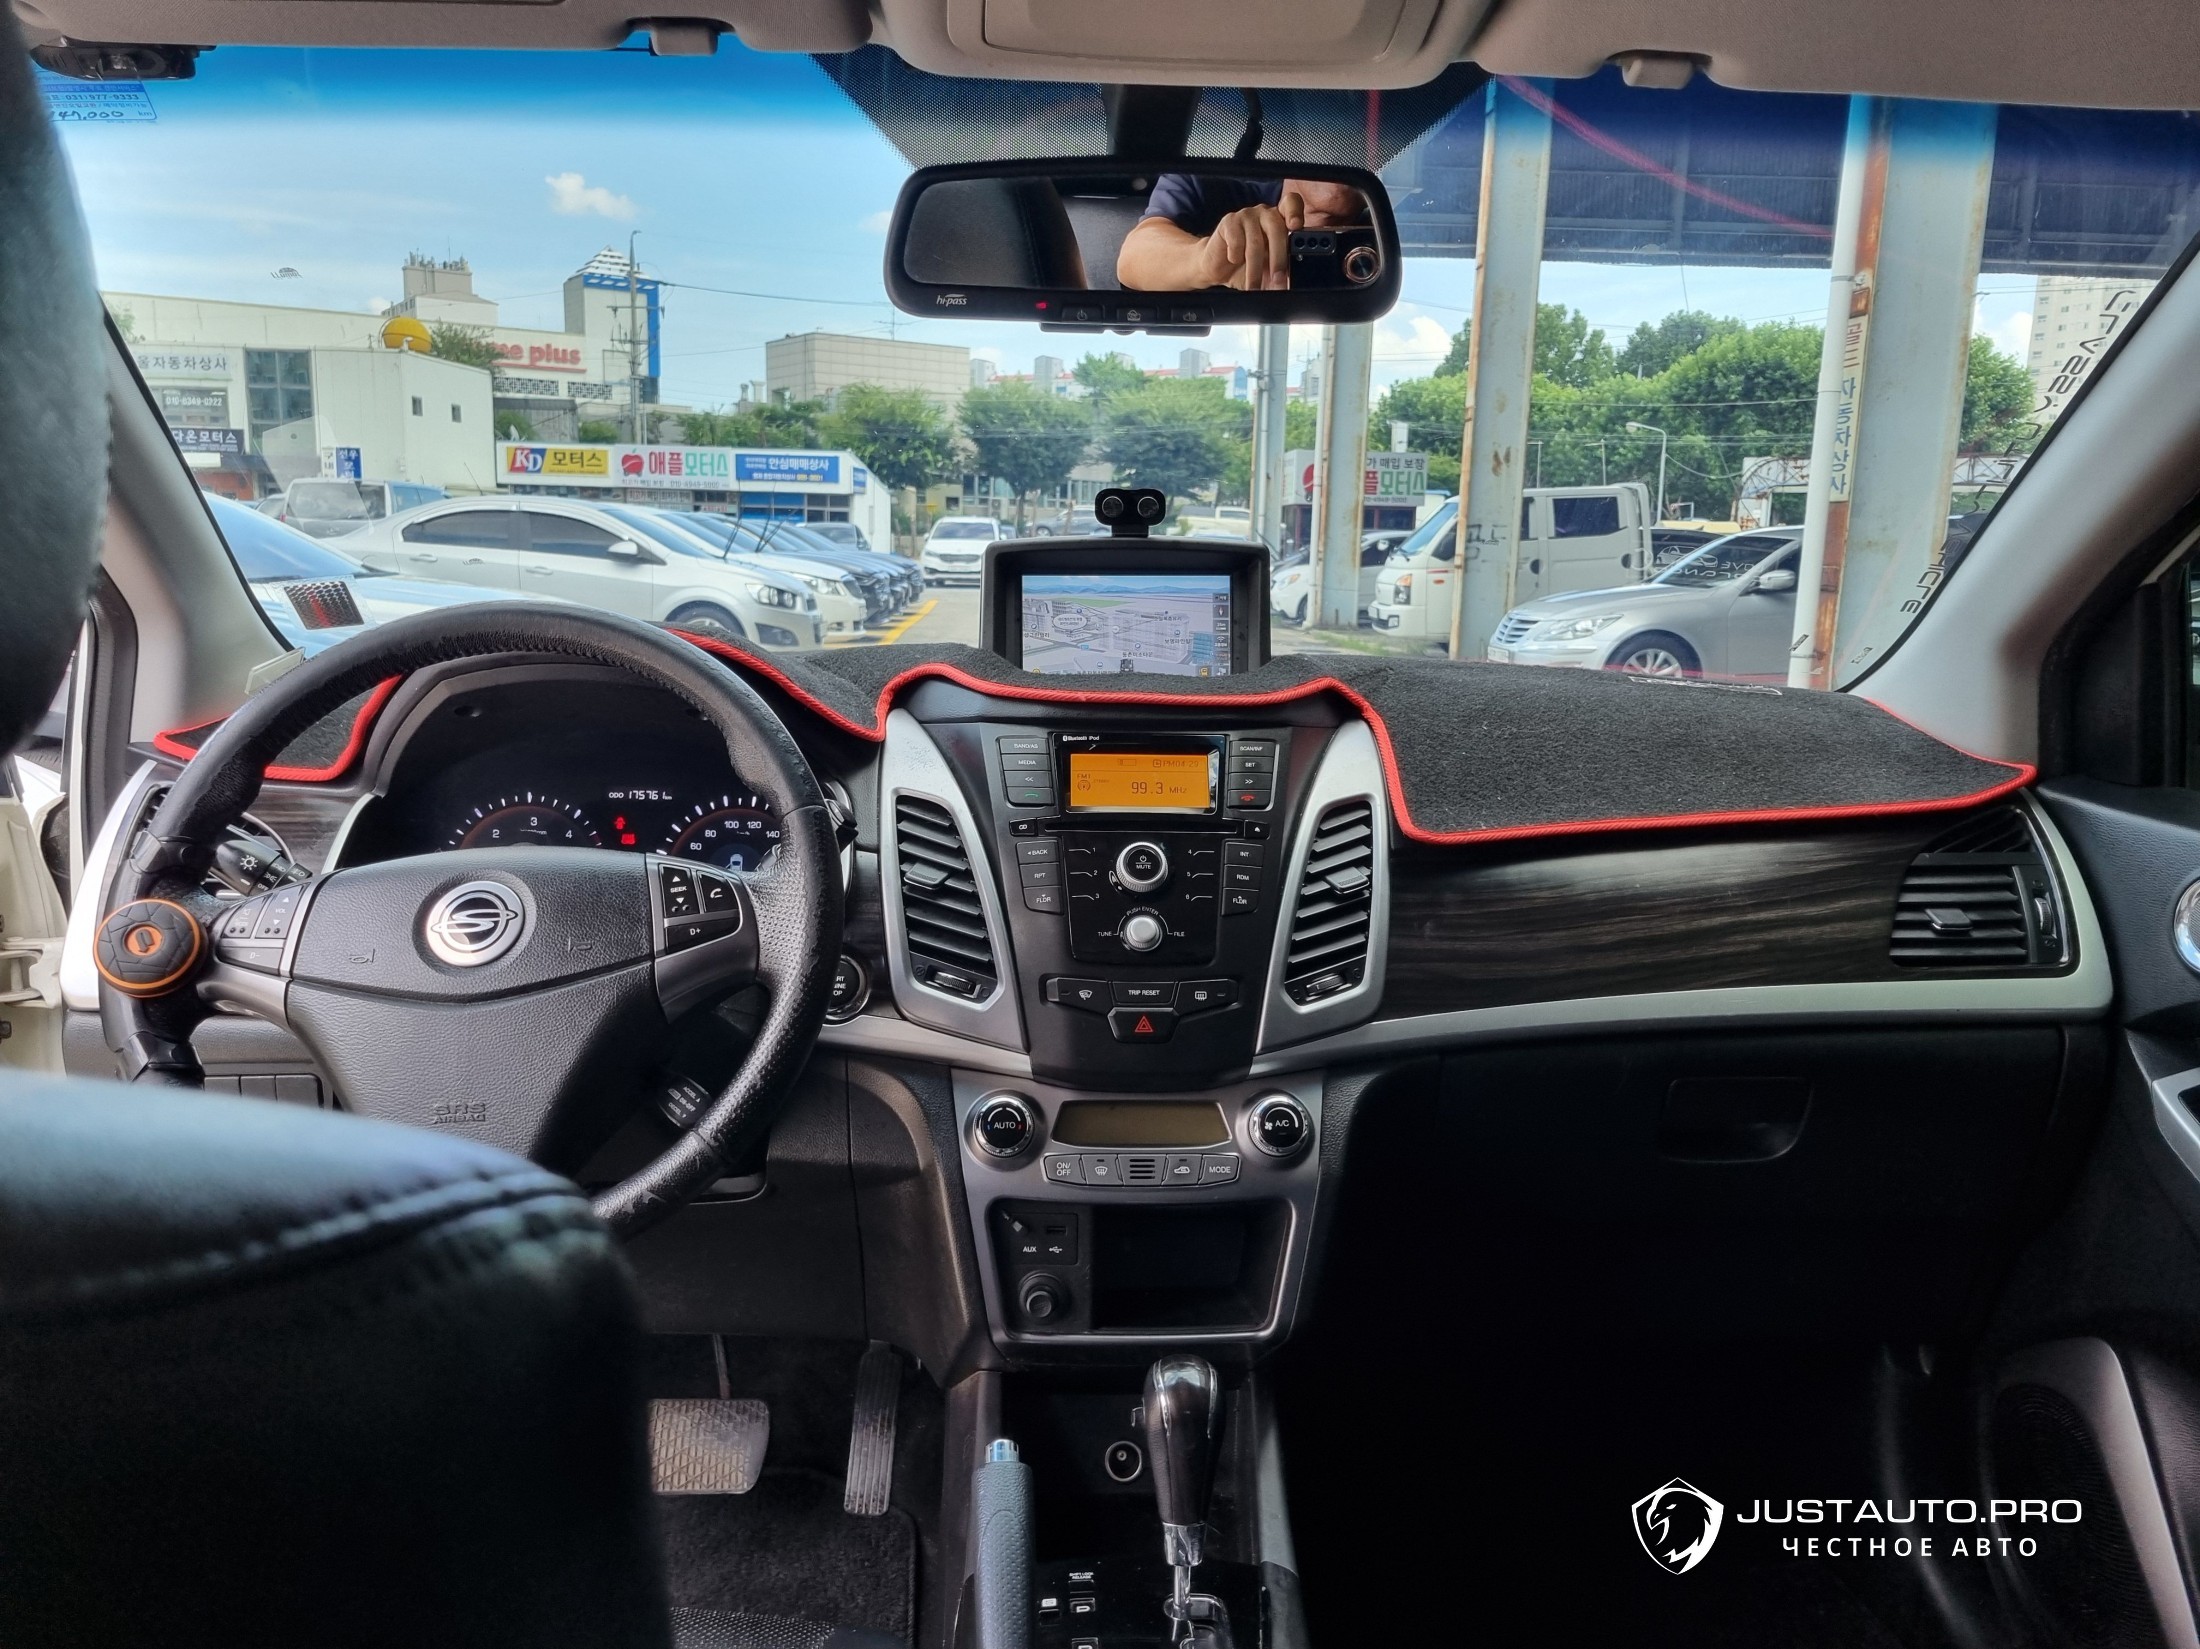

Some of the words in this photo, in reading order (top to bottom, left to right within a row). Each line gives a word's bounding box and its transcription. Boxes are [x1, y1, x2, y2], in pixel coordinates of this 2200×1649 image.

[529, 343, 581, 366] plus
[514, 449, 543, 472] KD
[551, 451, 603, 468] 모터스
[1380, 458, 1401, 469] 매입
[1403, 458, 1425, 471] 보장
[1131, 781, 1164, 795] 99.3
[608, 791, 625, 799] ODO
[530, 816, 538, 826] 3
[724, 821, 739, 829] 100
[747, 821, 762, 829] 120
[492, 828, 500, 839] 2
[565, 829, 573, 839] 4
[704, 829, 717, 838] 80
[766, 830, 780, 839] 140
[690, 842, 702, 851] 60
[670, 885, 687, 893] SEEK
[1126, 906, 1141, 917] PUSH
[1141, 906, 1159, 916] ENTER
[689, 927, 701, 936] D+
[433, 1103, 486, 1116] SRS
[432, 1114, 486, 1125] AIRBAG
[1275, 1119, 1290, 1128] A/C
[993, 1121, 1016, 1130] AUTO
[1056, 1162, 1071, 1170] ON/
[1209, 1166, 1231, 1174] MODE
[1056, 1169, 1071, 1177] OFF
[1022, 1245, 1037, 1253] AUX
